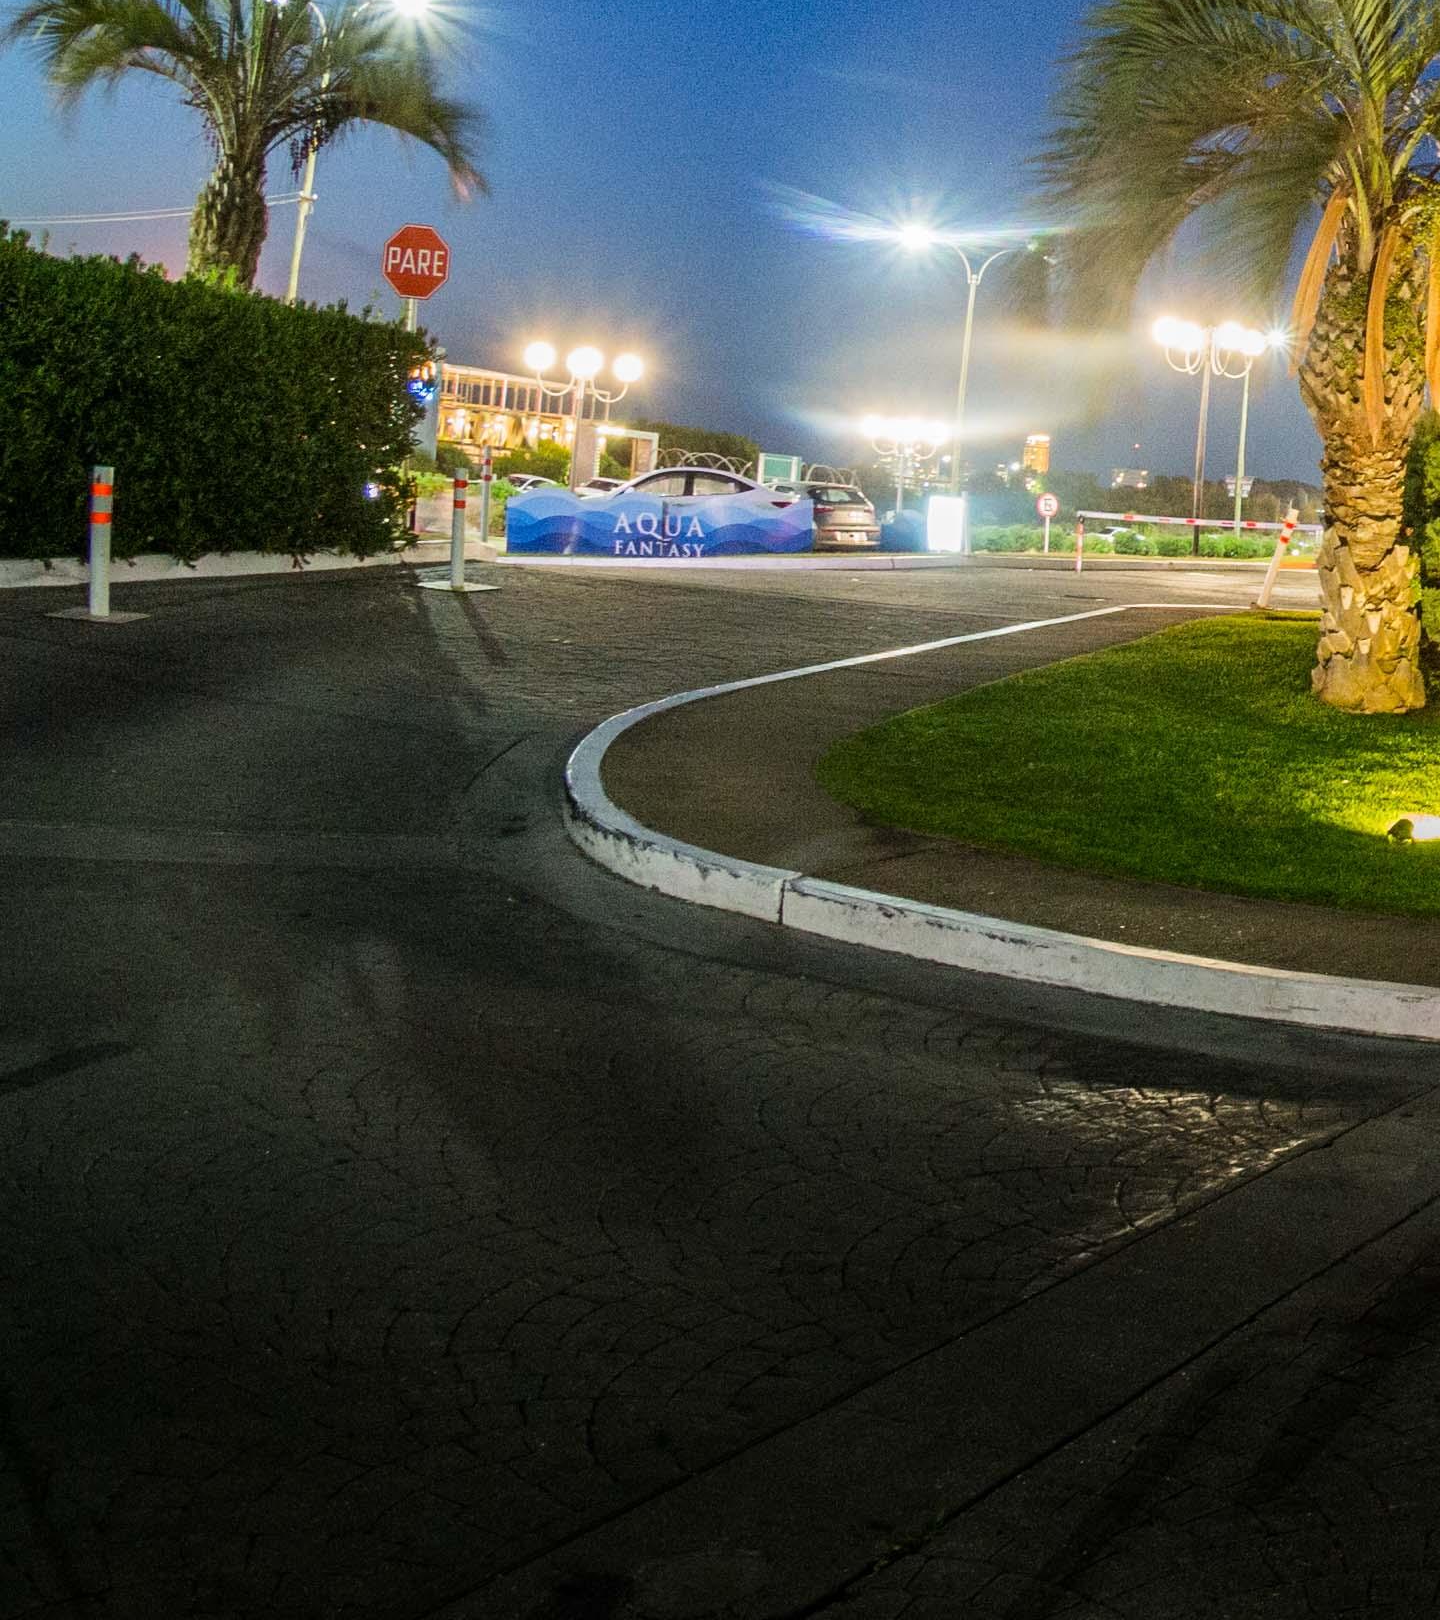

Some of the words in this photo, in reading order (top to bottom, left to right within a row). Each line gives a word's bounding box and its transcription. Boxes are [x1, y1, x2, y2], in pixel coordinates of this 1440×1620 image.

[387, 246, 446, 277] PARE
[613, 511, 705, 541] AQUA
[614, 539, 705, 558] FANTASY
